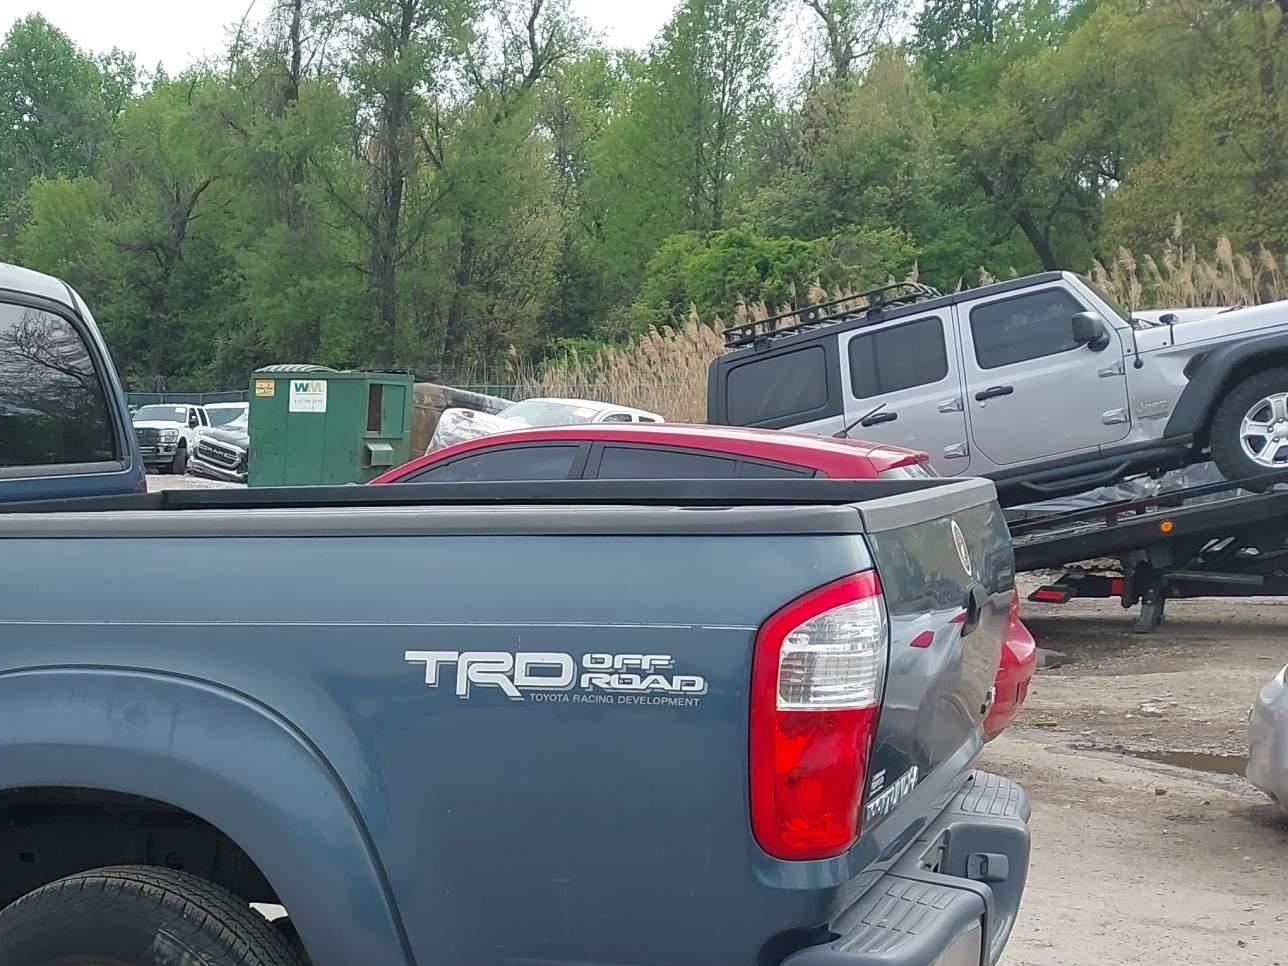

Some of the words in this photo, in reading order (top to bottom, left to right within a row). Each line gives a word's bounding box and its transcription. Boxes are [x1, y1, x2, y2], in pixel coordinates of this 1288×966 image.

[404, 650, 577, 700] TRD
[582, 653, 675, 672] OFF
[580, 673, 709, 695] ROAD
[529, 692, 570, 703] TOYOTA
[572, 694, 614, 705] RACING
[617, 695, 700, 707] DEVELOPMENT
